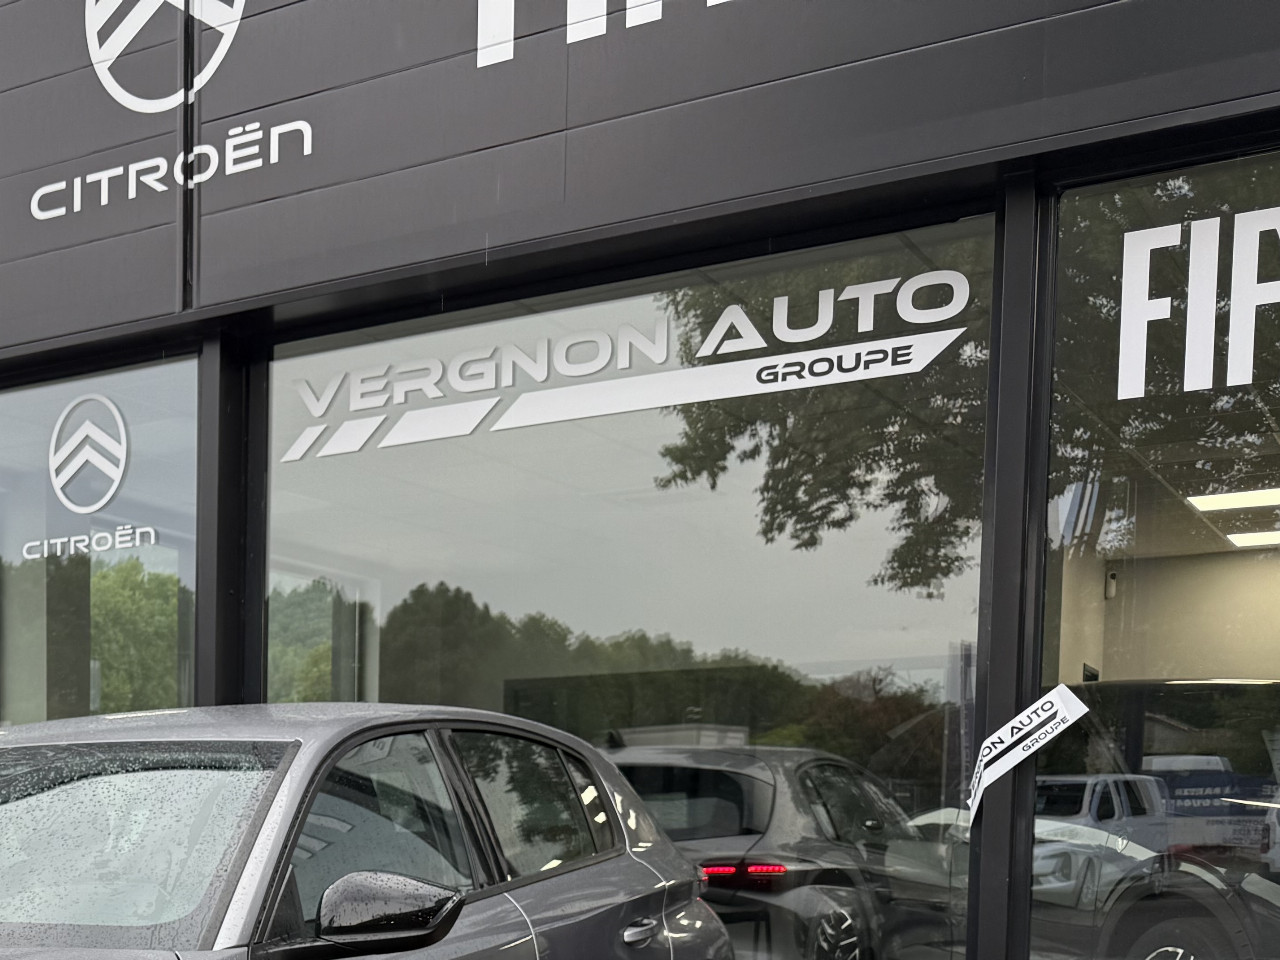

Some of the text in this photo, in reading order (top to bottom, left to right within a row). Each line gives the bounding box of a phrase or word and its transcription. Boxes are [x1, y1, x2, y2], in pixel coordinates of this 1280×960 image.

[297, 270, 971, 418] VERGNON AUTO
[754, 344, 914, 384] GROUPE
[1009, 700, 1055, 738] AUTO
[1021, 716, 1070, 752] GROUPE
